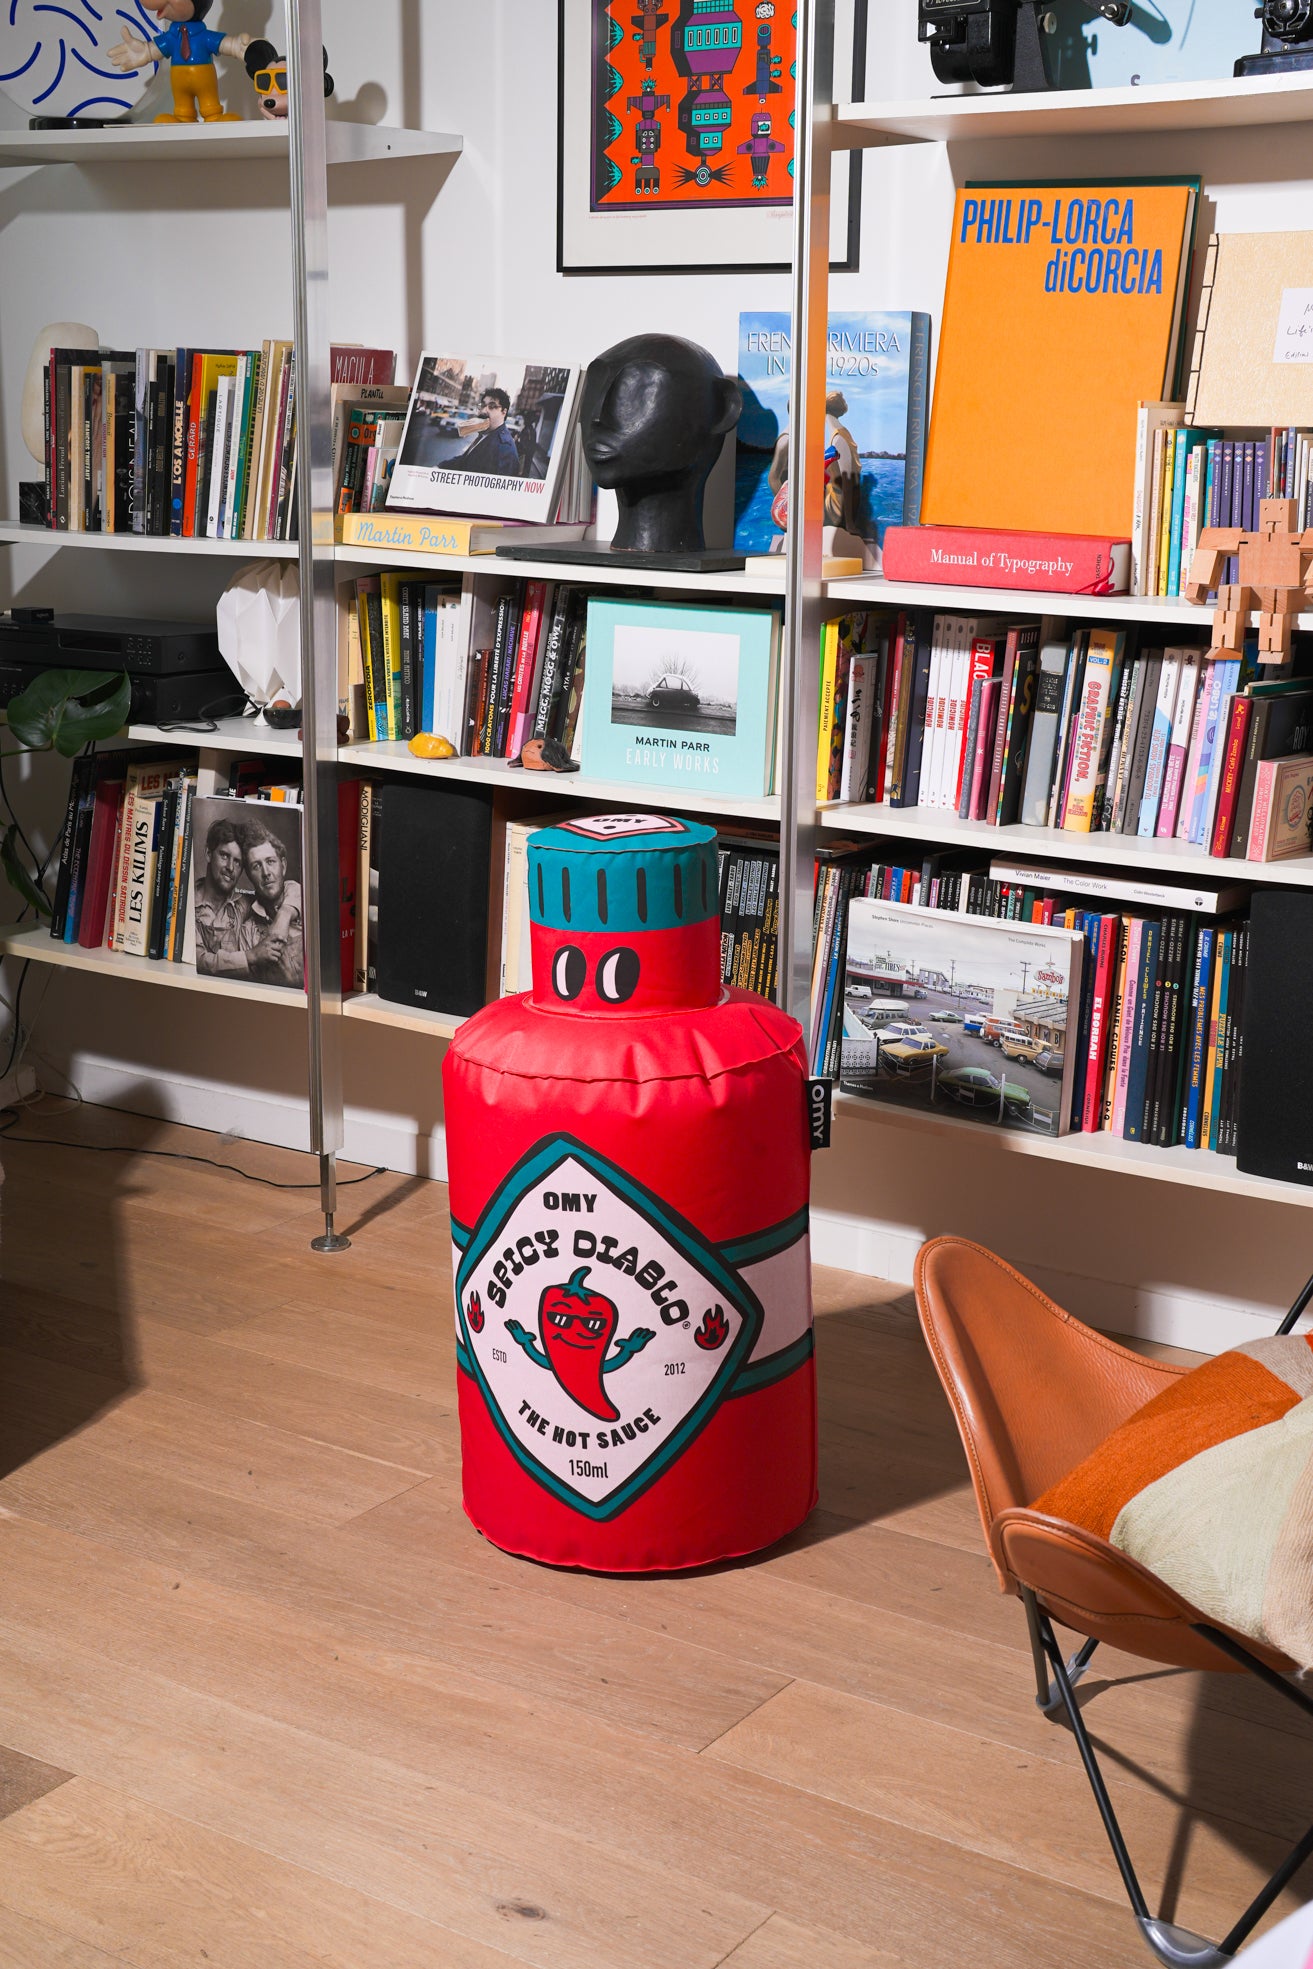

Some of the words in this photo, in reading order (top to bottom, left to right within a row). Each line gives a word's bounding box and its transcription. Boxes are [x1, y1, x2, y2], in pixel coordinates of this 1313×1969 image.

[960, 199, 1134, 244] PHILIP-LORCA
[1044, 248, 1162, 294] diCORCIA
[828, 332, 900, 353] RIVIERA
[766, 356, 785, 376] IN
[830, 356, 880, 377] 1920s
[912, 332, 924, 411] FRENCH
[174, 400, 184, 446] MOELLE
[909, 418, 921, 490] RIVIERA
[430, 471, 462, 486] STREET
[463, 474, 524, 492] PHOTOGRAPHY
[524, 481, 545, 494] NOW
[358, 522, 413, 545] Martin
[419, 527, 458, 549] Parr
[930, 548, 977, 566] Manual
[982, 552, 995, 566] of
[998, 553, 1073, 576] Typography
[492, 674, 498, 684] LA
[495, 598, 506, 648] D'EXPRESSION
[551, 624, 562, 649] OWL
[549, 652, 557, 660] &
[543, 662, 554, 694] MOGG
[1120, 668, 1129, 696] PERSONNE
[1083, 681, 1102, 731] GRAPHIC
[1210, 680, 1221, 708] LABO
[536, 697, 550, 730] MEGG,
[822, 707, 830, 732] PAIEMENT
[926, 696, 934, 728] HOMICIDE
[936, 697, 946, 728] HOMICIDE
[948, 699, 958, 730] HOMICIDE
[958, 700, 966, 731] HOMICIDE
[636, 736, 677, 749] MARTIN
[681, 741, 710, 752] PARR
[1075, 732, 1094, 782] FICTION,
[626, 748, 666, 768] EARLY
[674, 753, 719, 774] WORKS
[1225, 772, 1235, 794] MICKEY
[1231, 738, 1239, 756] Zombo
[64, 822, 72, 838] Paris
[68, 812, 74, 822] au
[360, 790, 369, 850] MODIGLIANI
[61, 848, 70, 864] Atlas
[63, 838, 70, 848] de
[130, 821, 148, 884] KILIMS
[121, 856, 130, 885] DESSIN
[1016, 870, 1034, 879] Vivian
[1034, 872, 1051, 881] Maier
[1076, 879, 1091, 887] Color
[1092, 882, 1108, 890] Work
[129, 890, 144, 923] LES
[1119, 925, 1129, 963] WILSON
[1094, 996, 1102, 1010] EL
[1128, 980, 1136, 997] Comme
[1112, 994, 1122, 1030] DANIEL
[1126, 1006, 1134, 1018] Gant
[1218, 1014, 1227, 1036] FUZZY
[1089, 1012, 1100, 1060] BORBAH
[1124, 1026, 1132, 1043] Velours
[1194, 1035, 1202, 1052] AVEC
[823, 1042, 831, 1074] casterman
[829, 1040, 837, 1072] casterman
[1109, 1032, 1120, 1072] CLOWES
[1191, 1064, 1199, 1088] FEMMES
[812, 1084, 825, 1140] omy
[542, 1191, 597, 1213] OMY
[486, 1229, 559, 1308] SPICY
[572, 1229, 690, 1326] DIABLO
[664, 1362, 686, 1376] 2012
[518, 1400, 550, 1436] THE
[552, 1426, 590, 1450] HOT
[597, 1406, 662, 1449] SAUCE
[568, 1458, 609, 1479] 150ml
